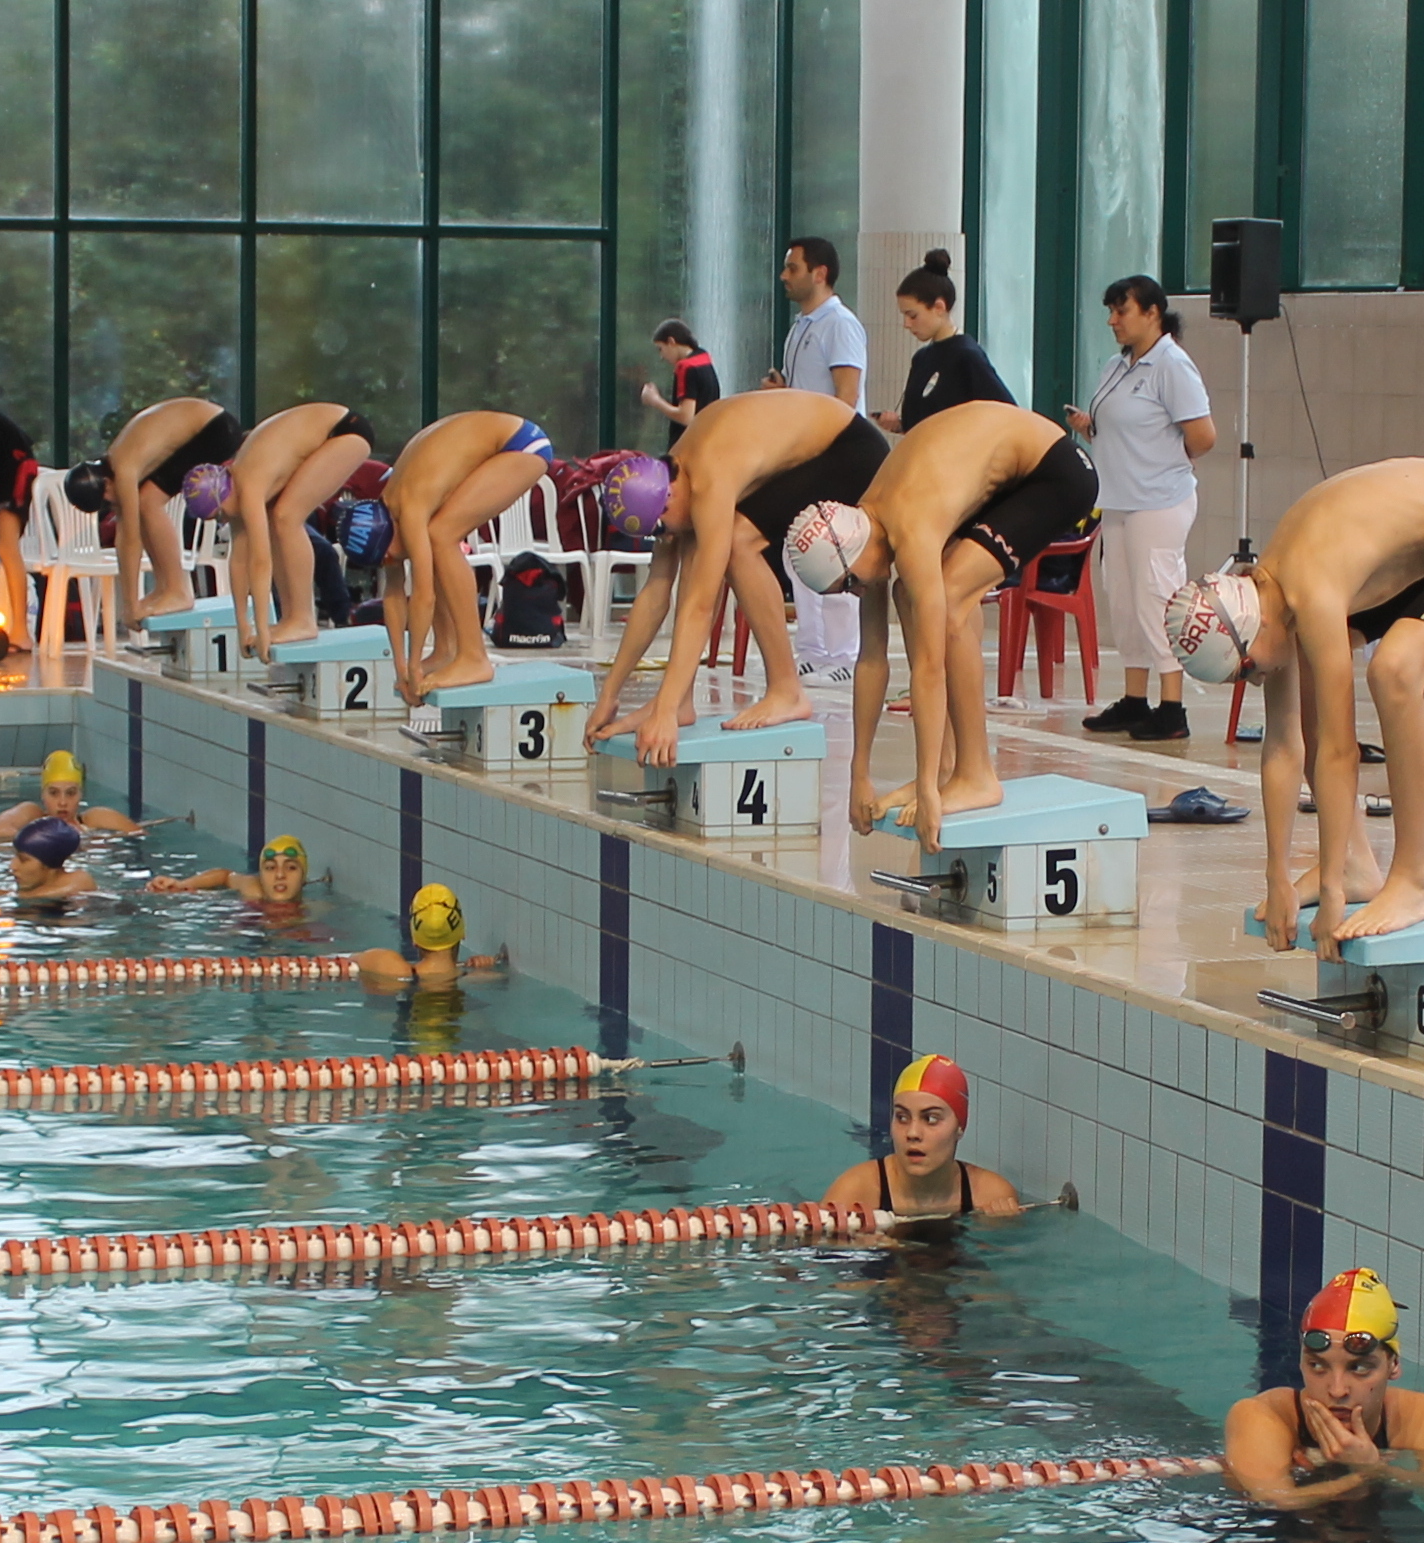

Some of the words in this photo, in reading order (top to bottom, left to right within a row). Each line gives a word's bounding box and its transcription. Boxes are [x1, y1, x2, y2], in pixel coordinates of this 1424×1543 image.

[346, 503, 374, 554] VIANA
[796, 505, 838, 554] BRAGA
[212, 633, 227, 672] 1
[345, 666, 368, 710] 2
[477, 723, 482, 753] 3
[519, 710, 545, 759] 3
[692, 781, 699, 815] 4
[737, 769, 768, 825] 4
[987, 862, 997, 903] 5
[1045, 848, 1078, 915] 5
